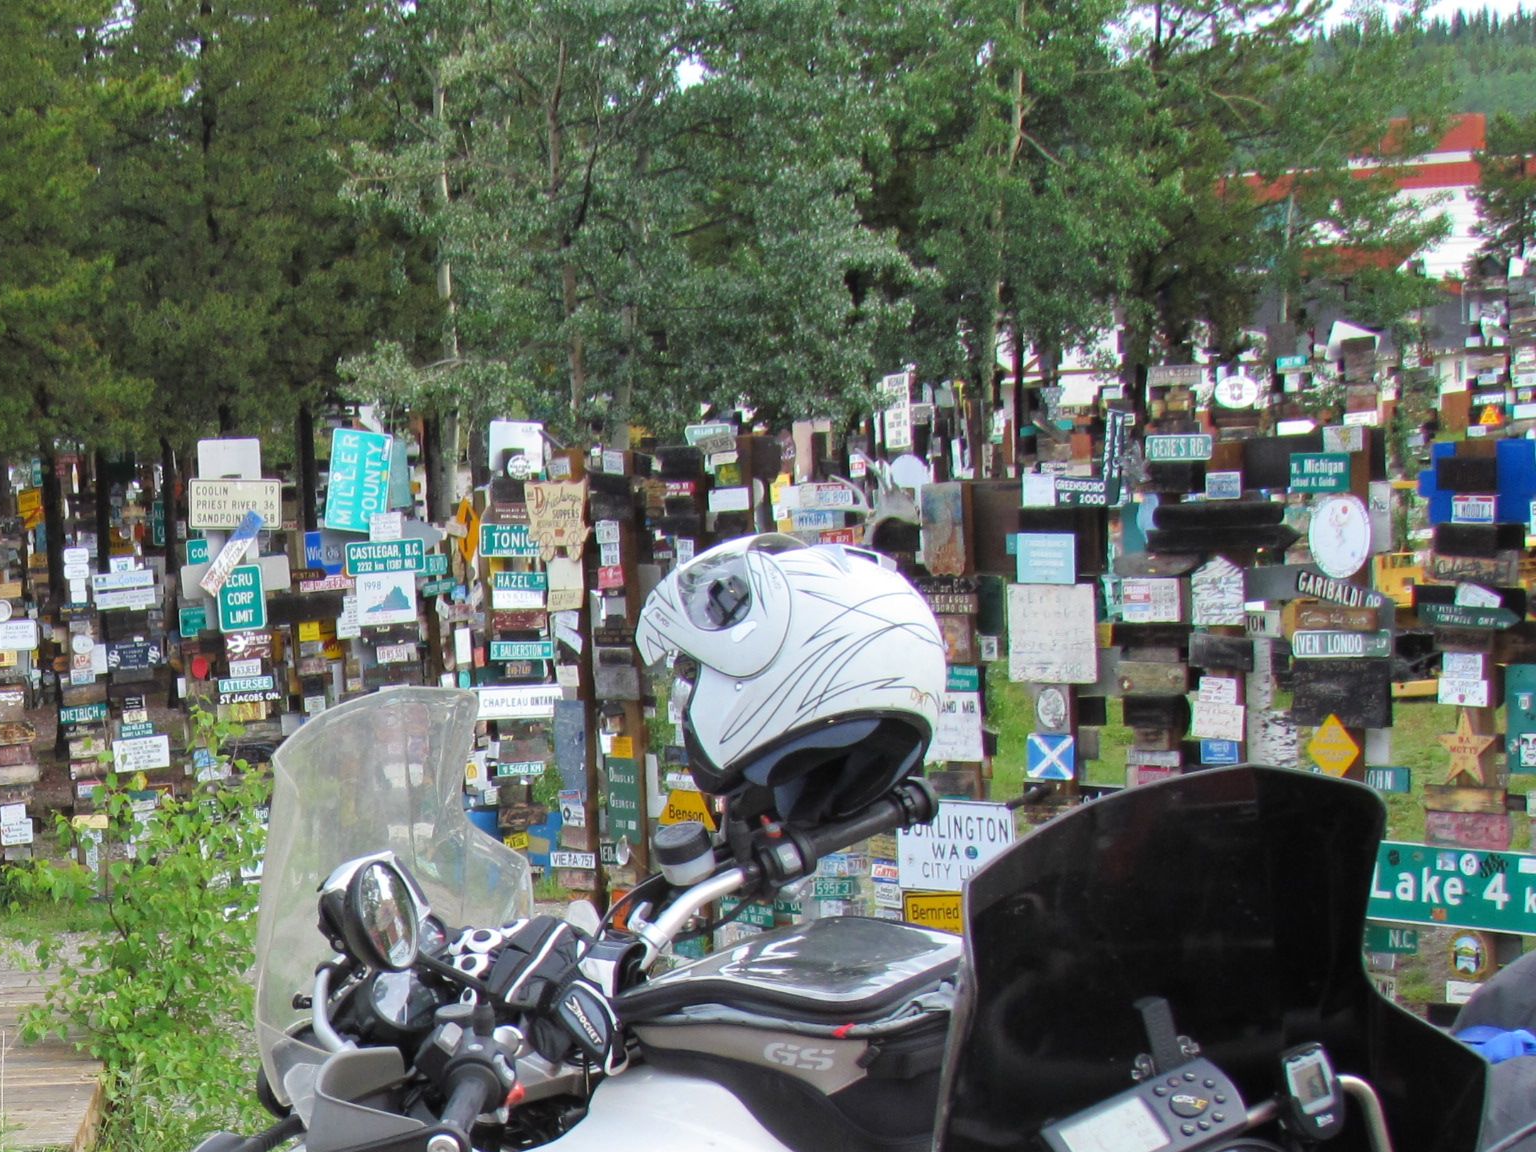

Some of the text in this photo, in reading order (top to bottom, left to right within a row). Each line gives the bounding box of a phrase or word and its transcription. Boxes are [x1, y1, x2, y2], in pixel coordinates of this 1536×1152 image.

[1303, 458, 1345, 475] Michigan
[334, 433, 360, 526] MILLER
[359, 441, 384, 523] COUNTY
[1055, 480, 1105, 493] GREENSBORO
[195, 485, 275, 497] COOLIN 19
[1059, 492, 1106, 504] NC 2000
[196, 499, 275, 510] PRIEST RIVER 36
[264, 513, 276, 523] 58
[225, 573, 254, 586] ECRU
[496, 574, 530, 588] HAZEL
[1297, 570, 1363, 606] GARIBALDI
[227, 593, 254, 606] CORP
[229, 610, 254, 624] LIMIT
[223, 677, 271, 692] ATTERSEE
[232, 692, 265, 704] JACOBS
[482, 696, 529, 708] CHAPLEAU
[59, 706, 100, 722] DIETRICH
[668, 805, 705, 823] Benson
[931, 842, 960, 860] WA
[921, 862, 955, 880] CITY
[1369, 862, 1463, 906] Lake
[1482, 872, 1510, 911] 4
[911, 903, 961, 921] Bernried
[763, 1042, 836, 1071] GS
